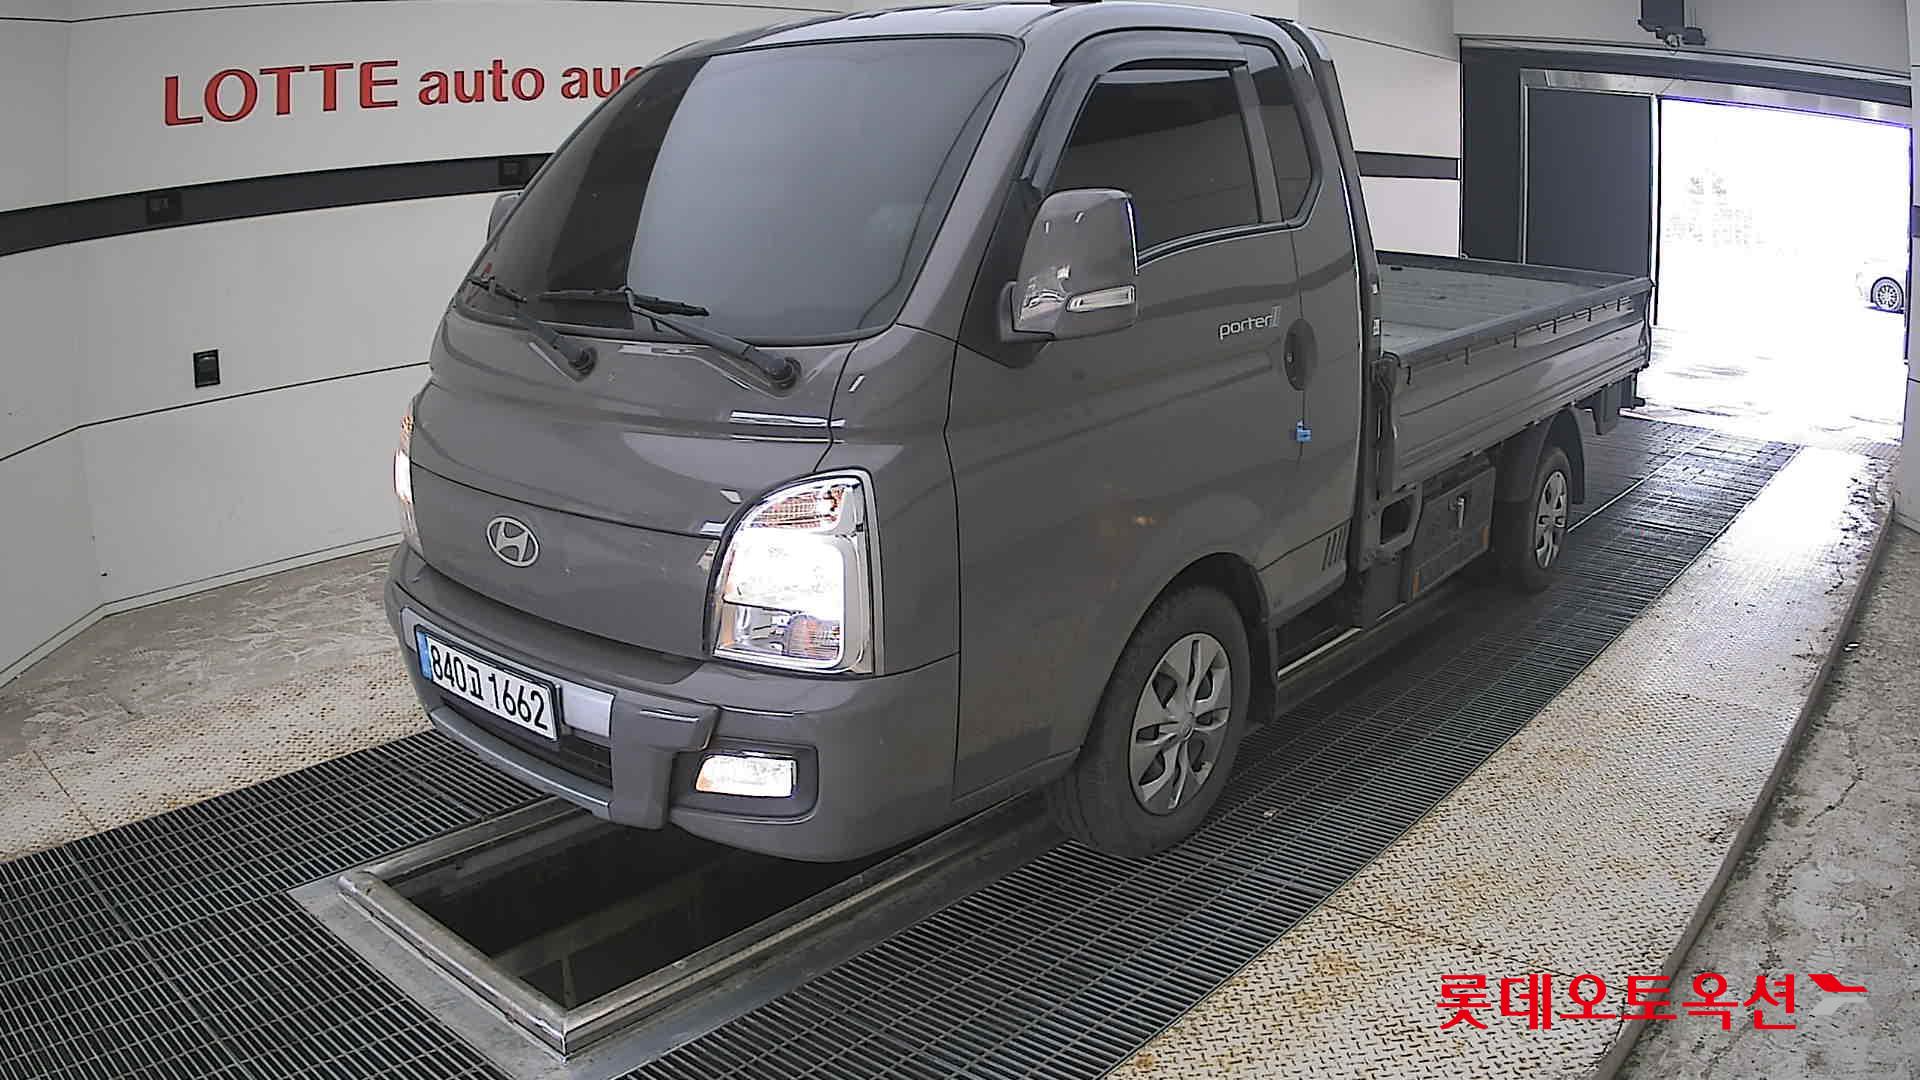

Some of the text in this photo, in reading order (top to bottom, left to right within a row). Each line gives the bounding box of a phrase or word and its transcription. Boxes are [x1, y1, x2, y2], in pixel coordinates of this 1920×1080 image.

[164, 60, 398, 126] LOTTE
[418, 59, 545, 105] auto
[488, 672, 548, 731] 1662
